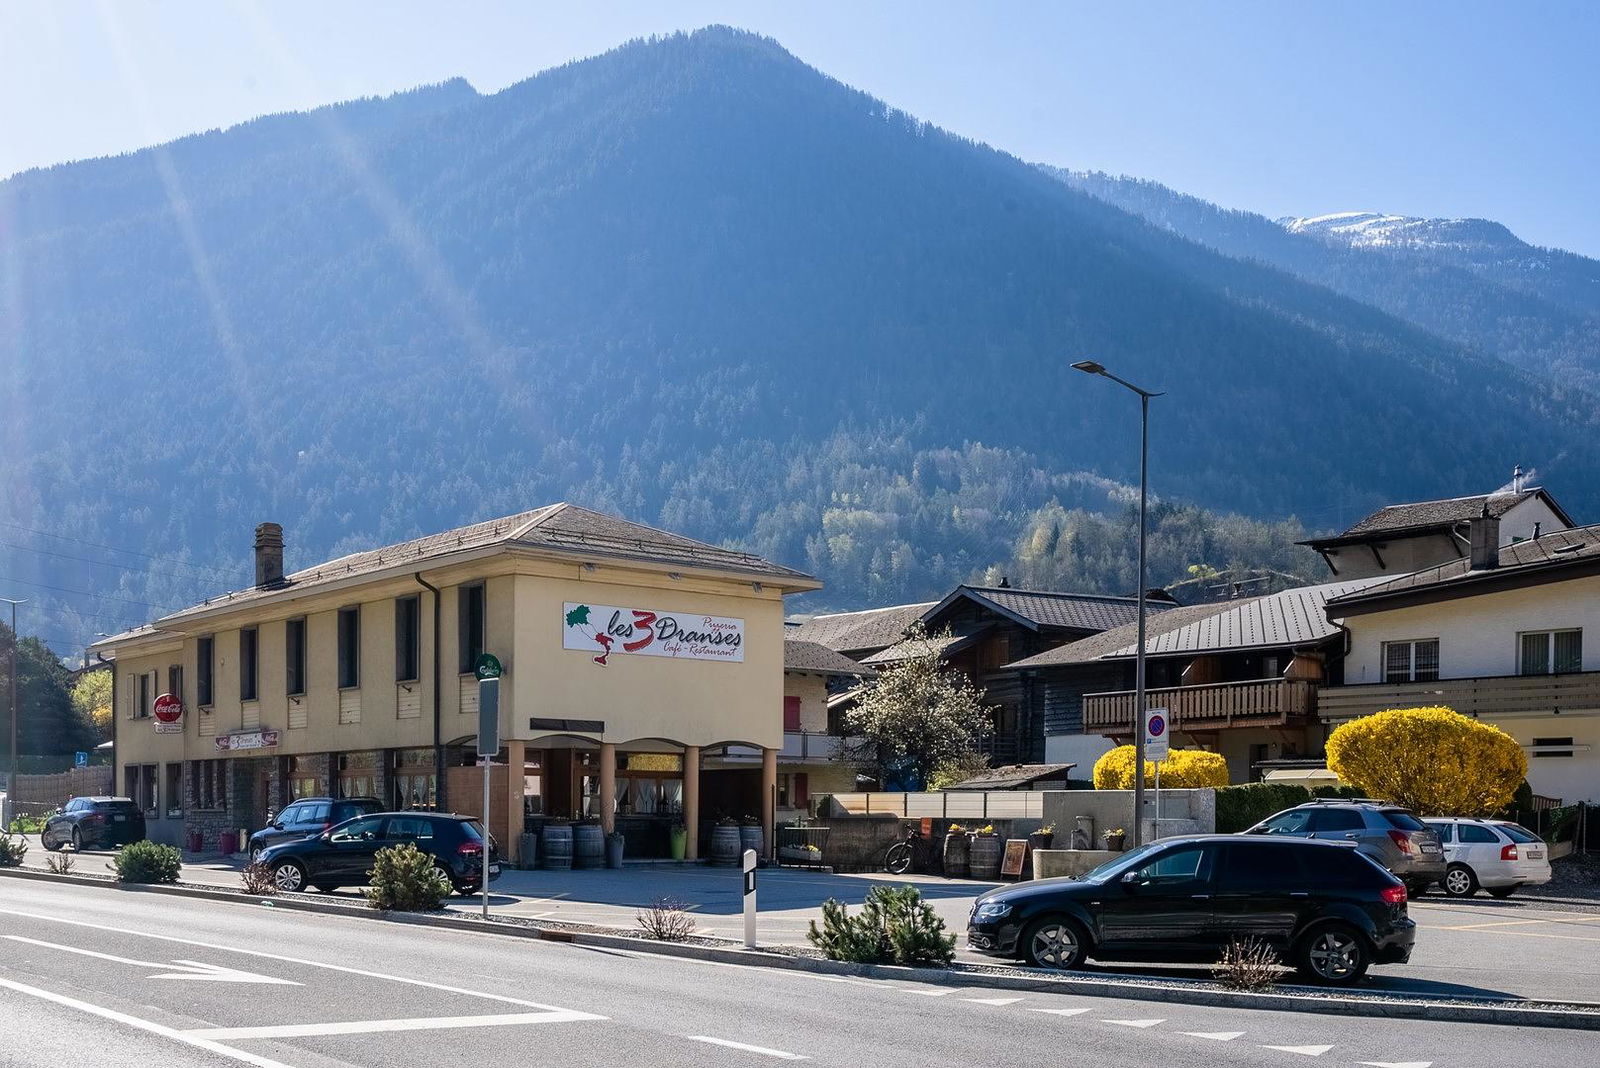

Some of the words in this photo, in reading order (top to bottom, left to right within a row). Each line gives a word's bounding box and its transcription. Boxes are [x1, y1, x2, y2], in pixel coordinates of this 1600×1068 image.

[607, 610, 633, 638] les
[622, 610, 657, 652] 3
[655, 616, 742, 646] Dranses
[663, 641, 682, 657] Café
[688, 646, 737, 658] Restaurant
